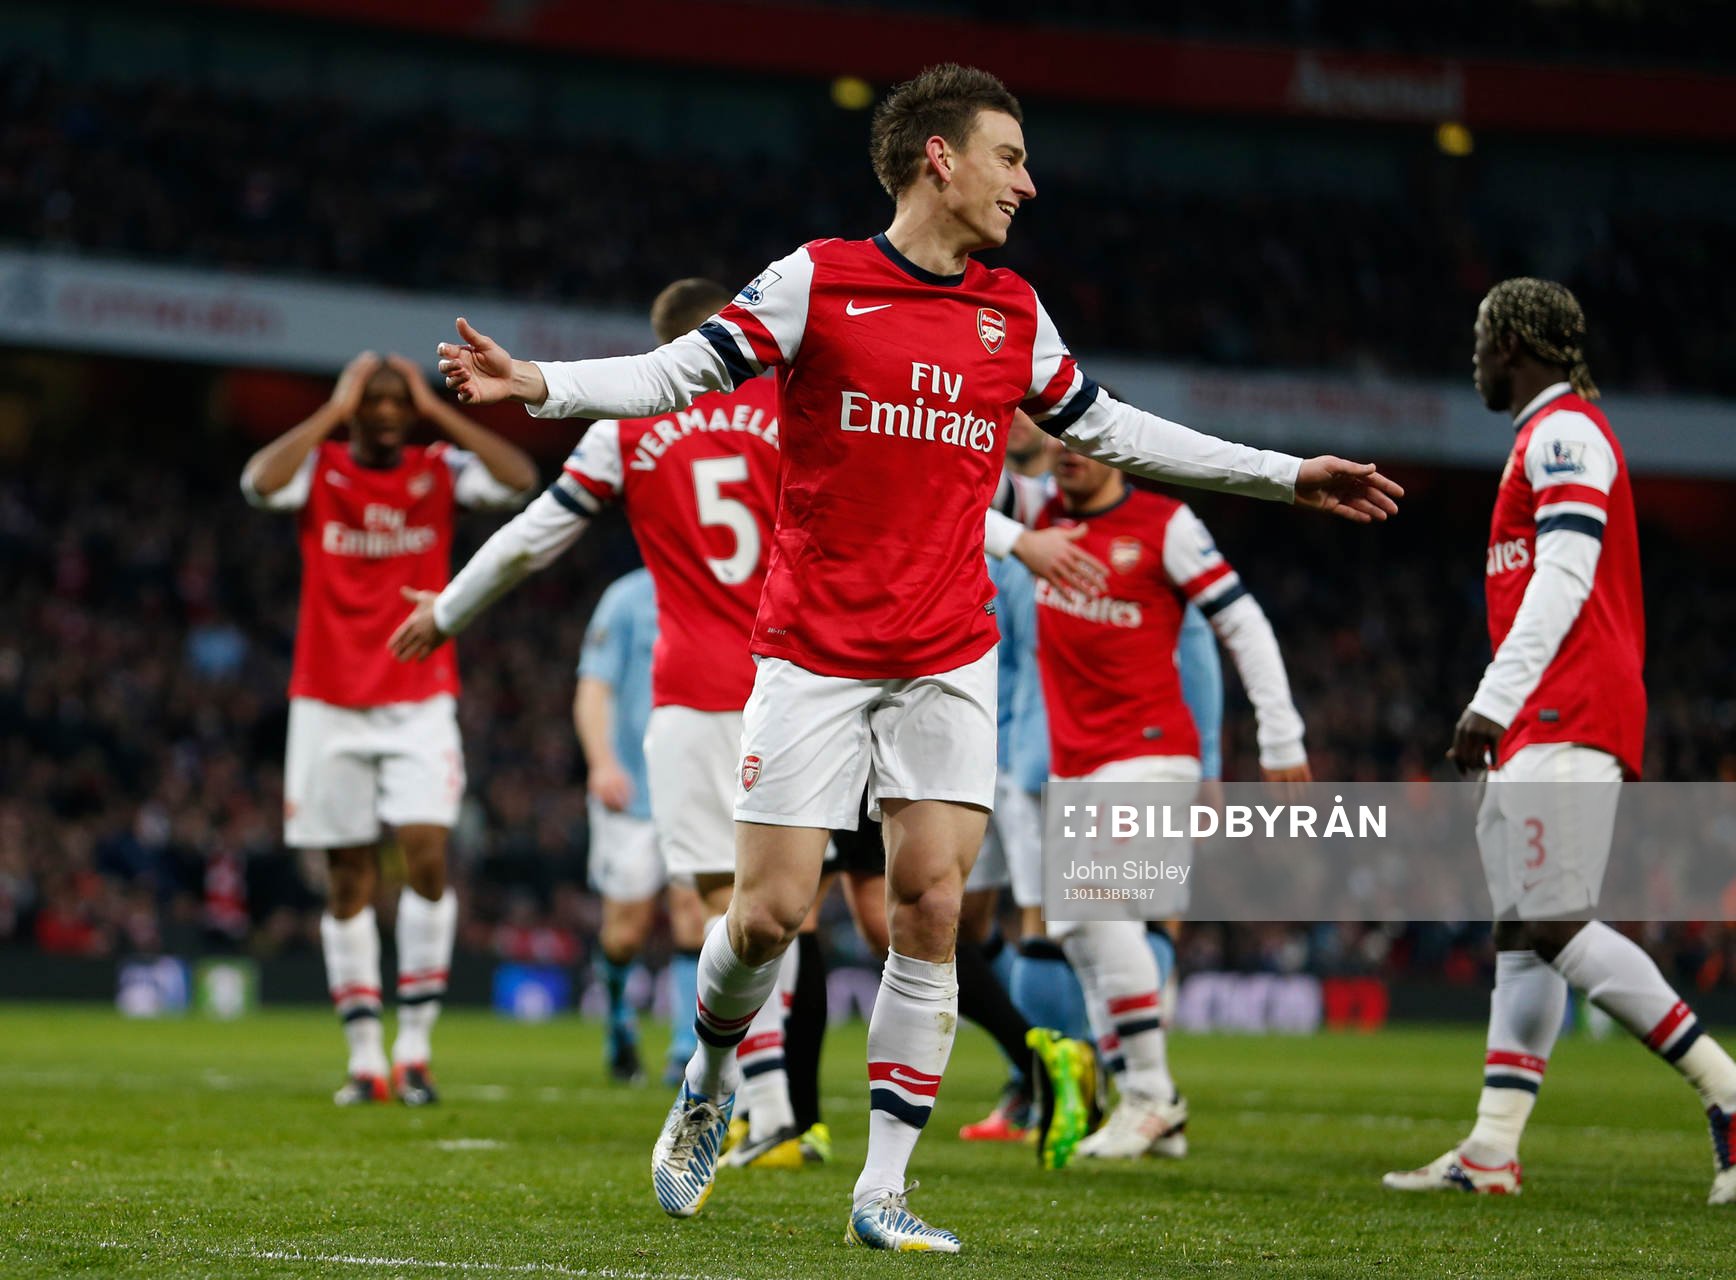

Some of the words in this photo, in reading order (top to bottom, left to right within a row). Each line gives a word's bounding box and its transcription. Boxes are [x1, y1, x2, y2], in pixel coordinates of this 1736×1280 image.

[911, 361, 963, 403] Fly
[840, 390, 997, 453] Emirates
[691, 454, 762, 587] 5
[1523, 816, 1547, 872] 3
